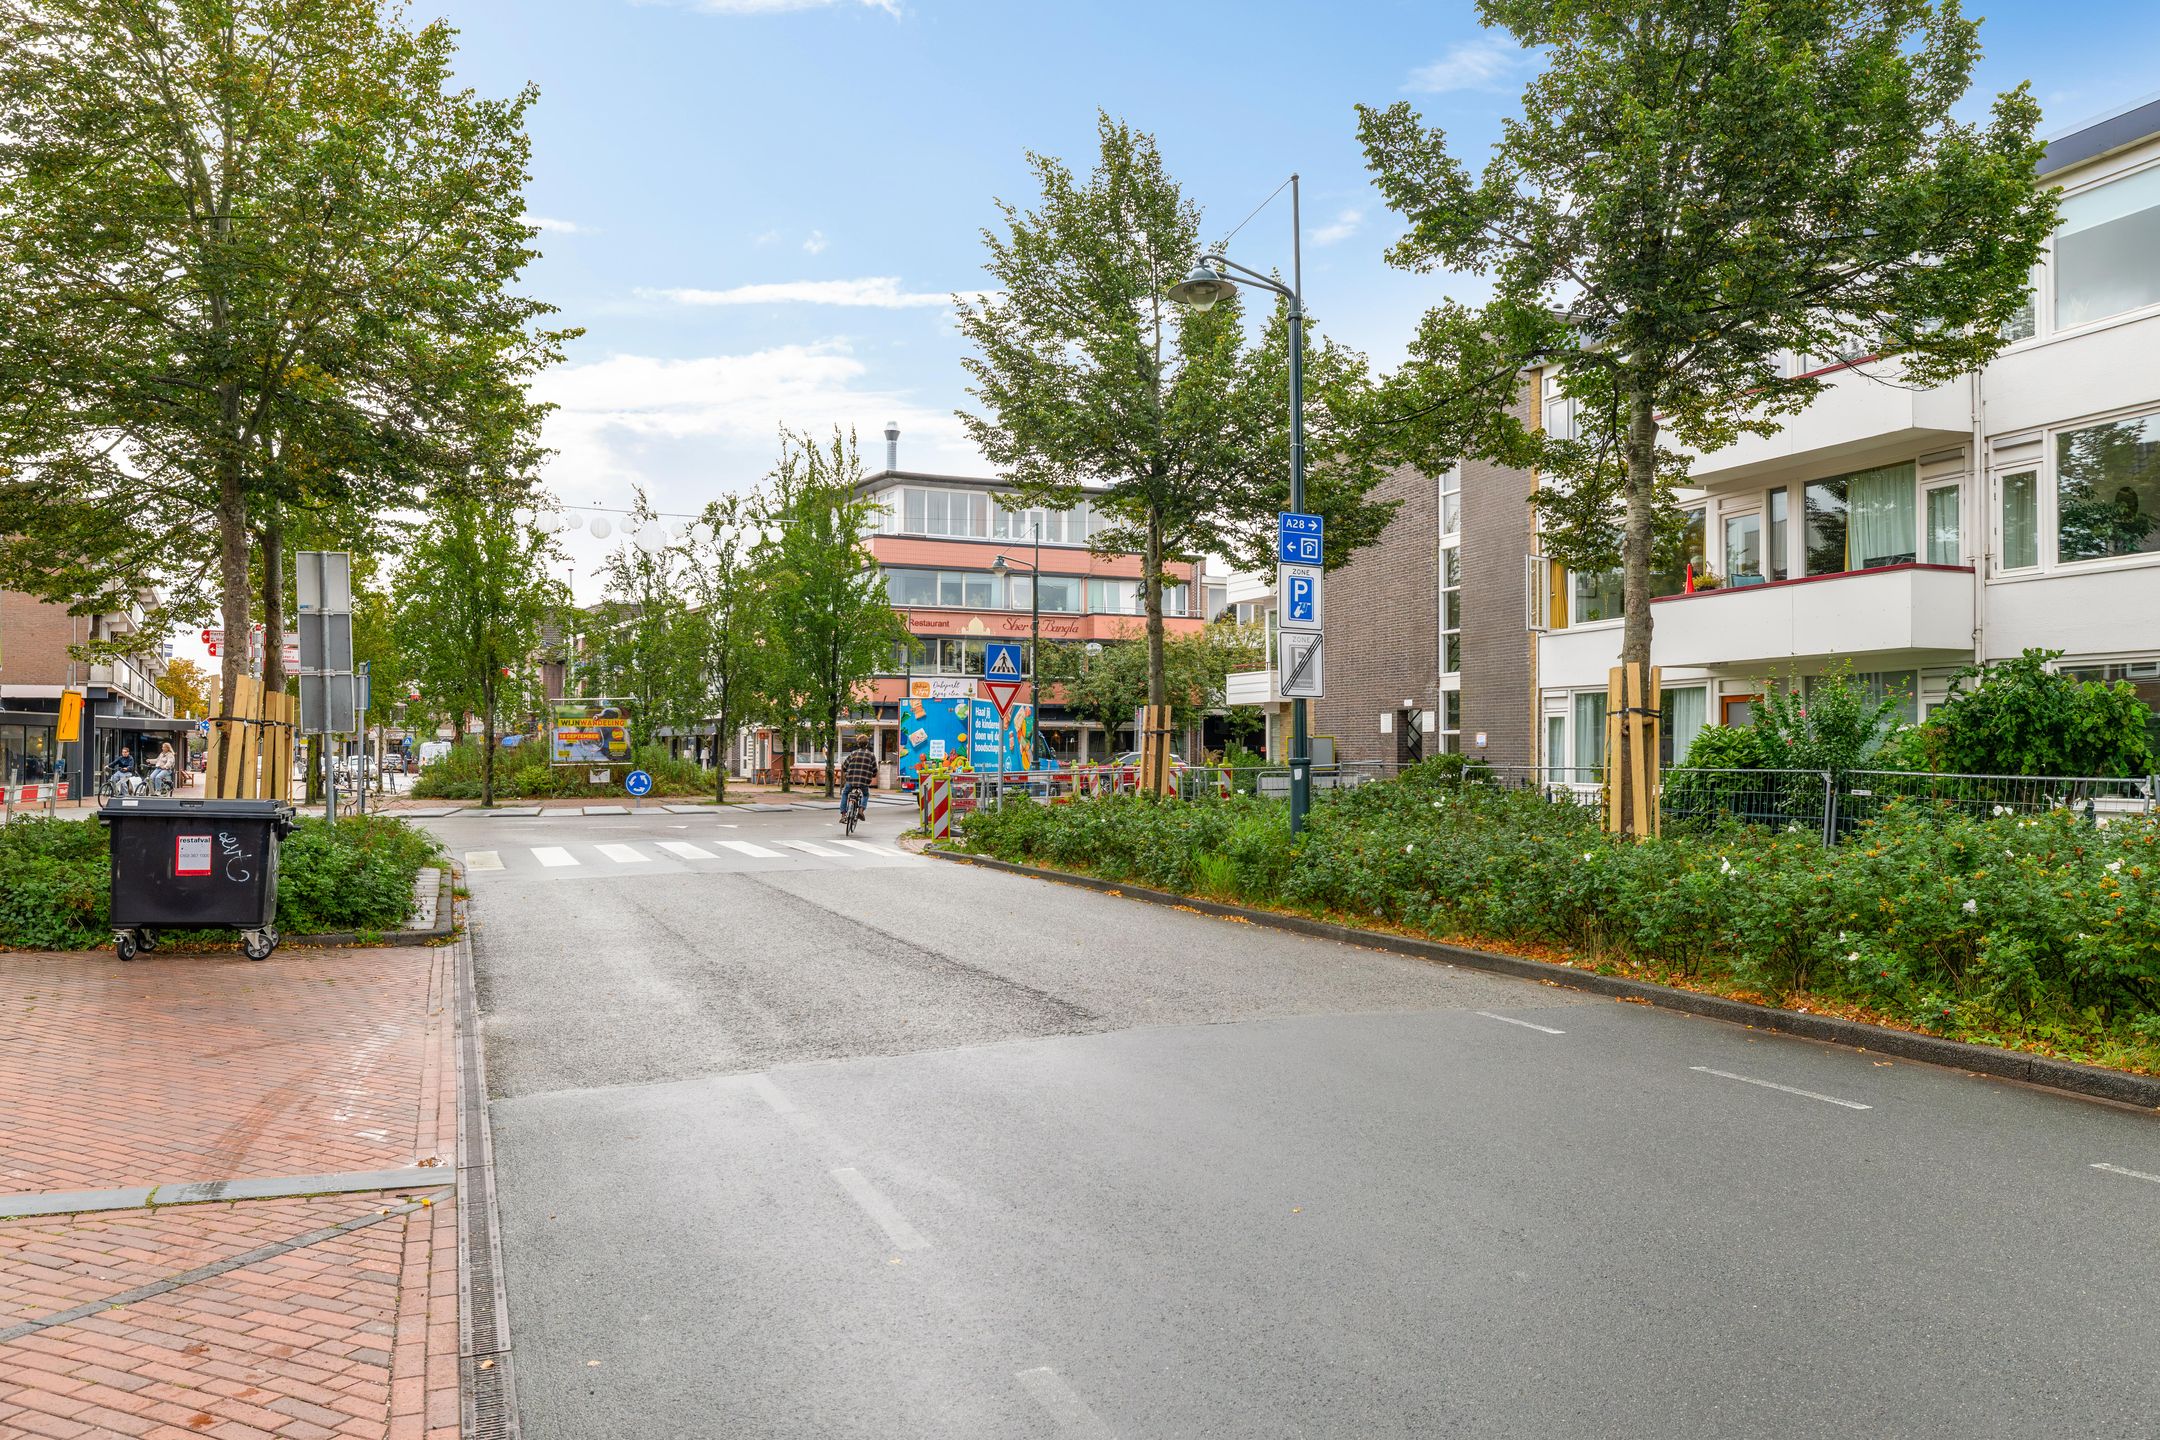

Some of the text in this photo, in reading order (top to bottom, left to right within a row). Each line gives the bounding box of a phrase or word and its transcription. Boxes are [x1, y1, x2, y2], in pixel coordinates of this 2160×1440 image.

[1286, 519, 1305, 529] A28
[1306, 545, 1313, 554] P
[1292, 568, 1310, 576] ZONE
[1294, 580, 1308, 602] P
[910, 619, 950, 628] Restaurant
[1002, 616, 1029, 631] Sher
[1041, 619, 1080, 637] Bangla
[975, 706, 986, 717] Haal
